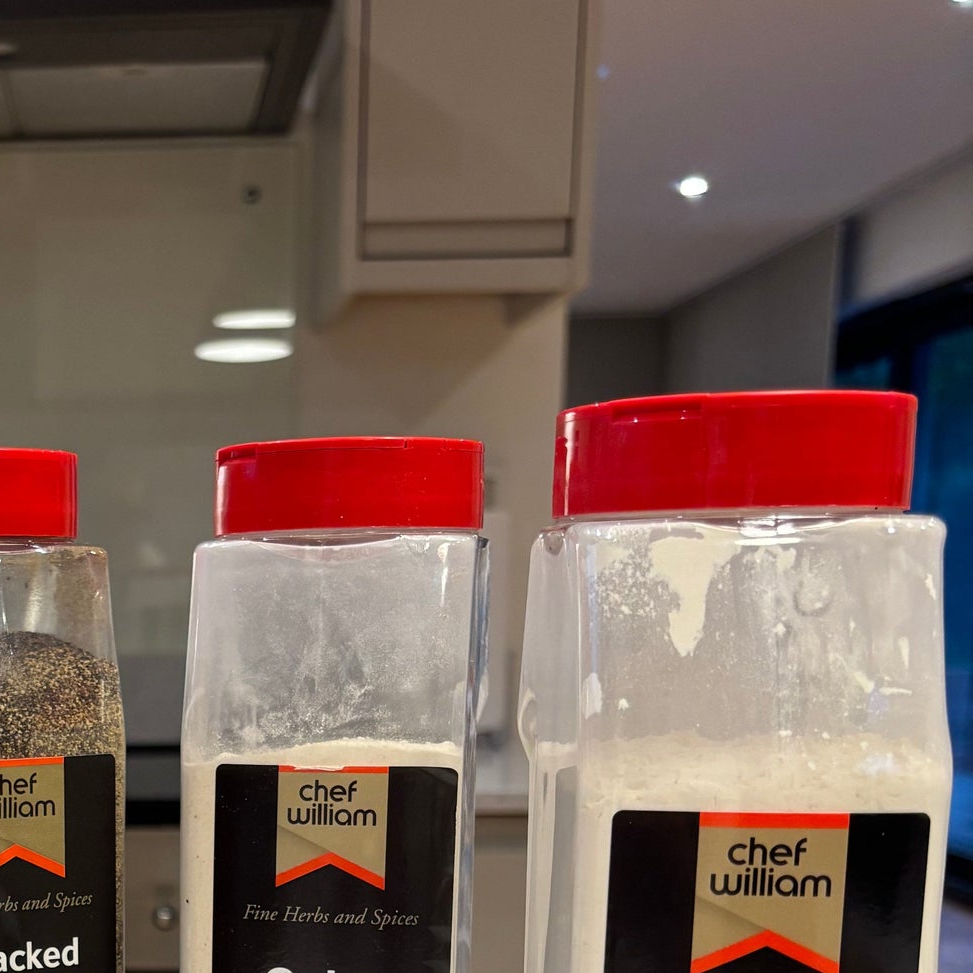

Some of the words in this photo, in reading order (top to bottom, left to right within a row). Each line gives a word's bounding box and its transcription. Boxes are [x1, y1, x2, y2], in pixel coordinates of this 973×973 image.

[299, 780, 357, 802] chef
[287, 804, 377, 826] william
[728, 837, 808, 866] chef
[710, 868, 830, 897] william
[22, 891, 50, 911] and
[53, 891, 93, 914] Spices
[243, 904, 278, 921] Fine
[283, 906, 329, 924] Herbs
[334, 908, 366, 925] and
[371, 909, 419, 930] Spices
